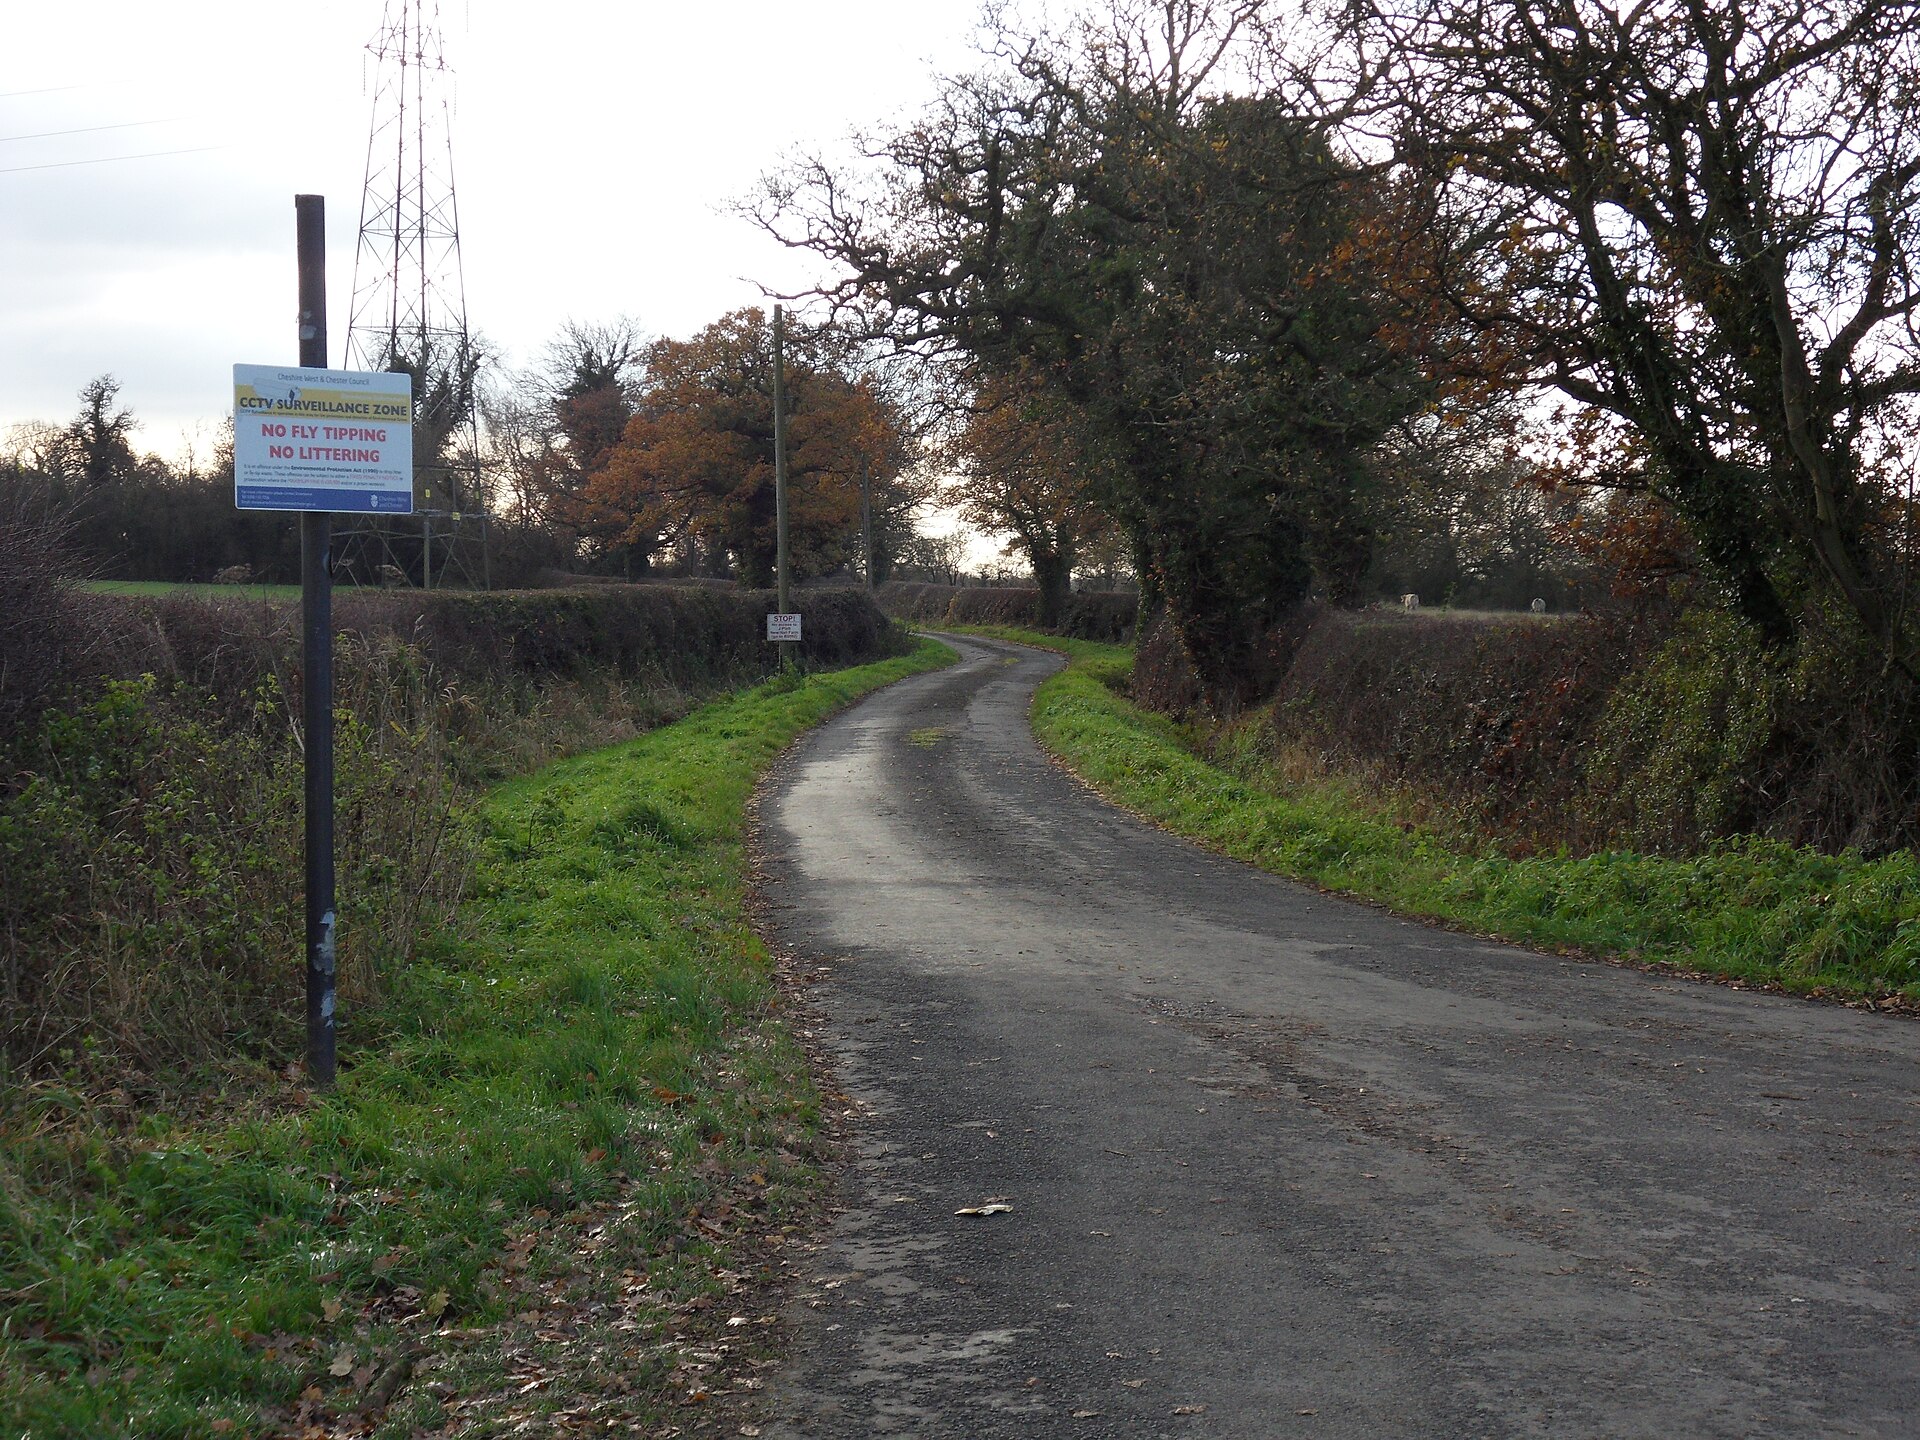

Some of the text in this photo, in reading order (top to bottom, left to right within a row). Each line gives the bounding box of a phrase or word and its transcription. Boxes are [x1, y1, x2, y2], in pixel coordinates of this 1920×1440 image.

[277, 373, 303, 382] Cheshire
[304, 375, 319, 383] West
[326, 376, 348, 385] Chester
[349, 377, 370, 386] Council
[240, 397, 273, 409] CCTV
[277, 398, 369, 414] SURVEILLANCE
[372, 404, 407, 416] ZONE
[261, 423, 386, 442] NO FLY TIPPING
[269, 445, 380, 463] NO LITTERING
